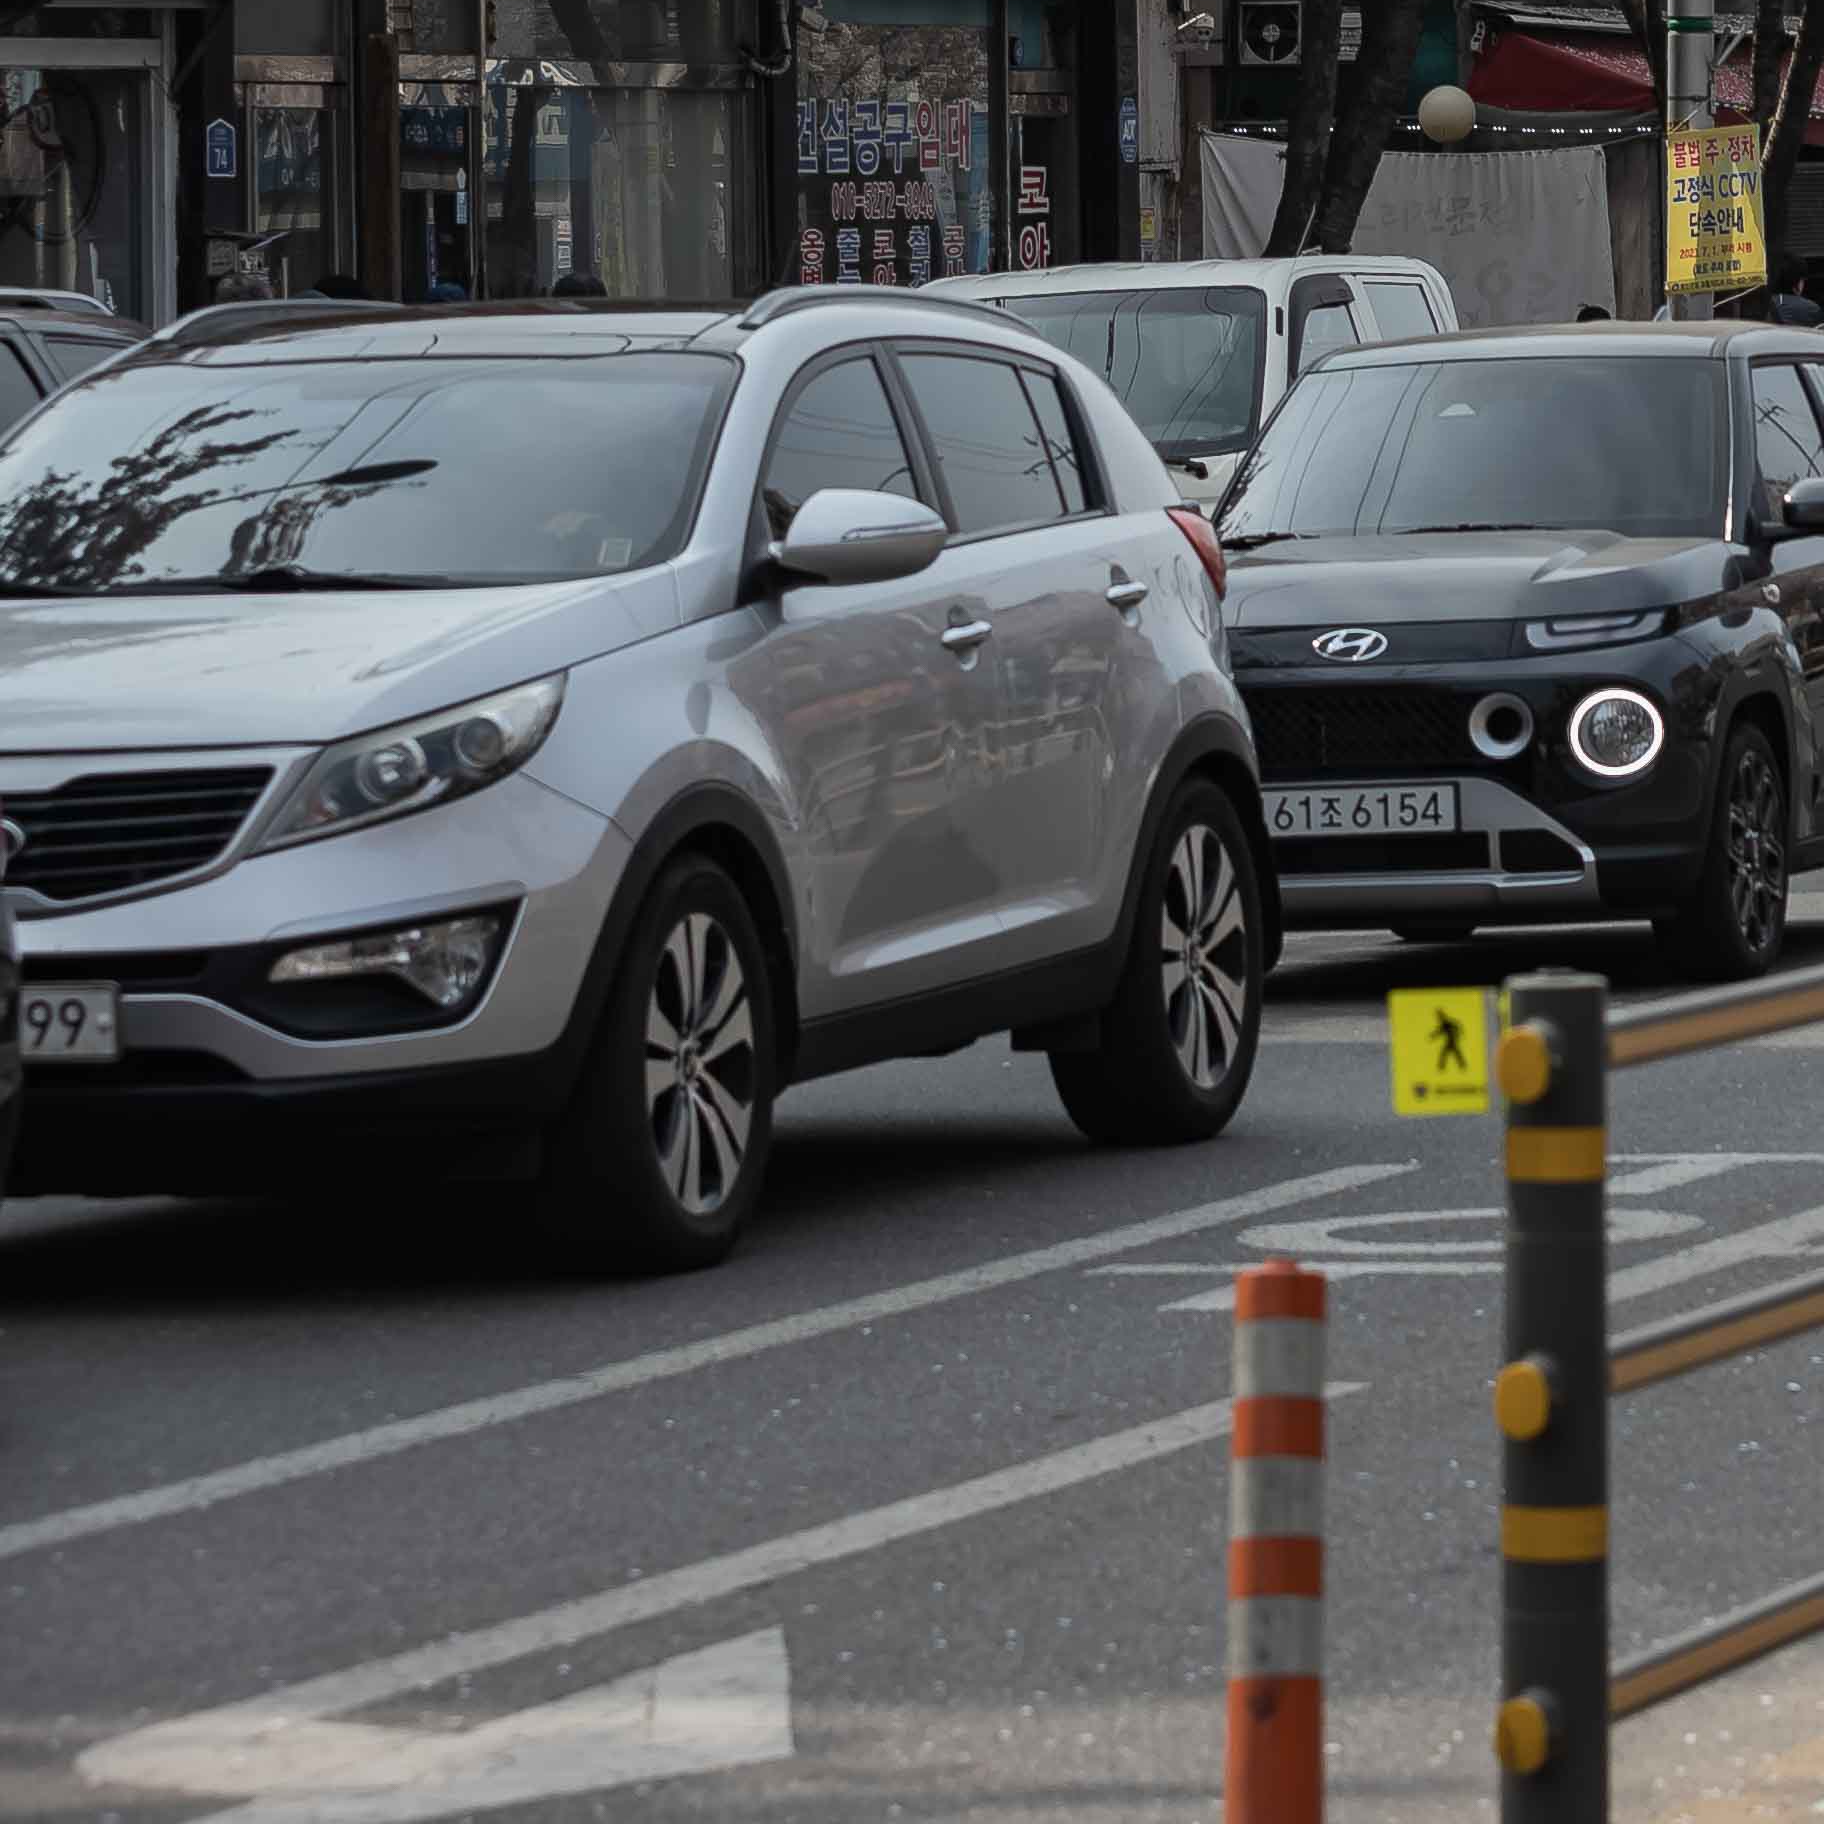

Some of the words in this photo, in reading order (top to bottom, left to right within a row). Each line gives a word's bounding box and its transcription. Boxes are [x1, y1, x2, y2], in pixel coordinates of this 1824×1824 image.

[797, 97, 972, 175] 건설공구임대
[213, 147, 228, 169] 74
[1674, 141, 1701, 169] 불법
[1673, 176, 1715, 204] 고정식
[1718, 172, 1758, 199] CCTV
[1689, 206, 1745, 238] 단속안내
